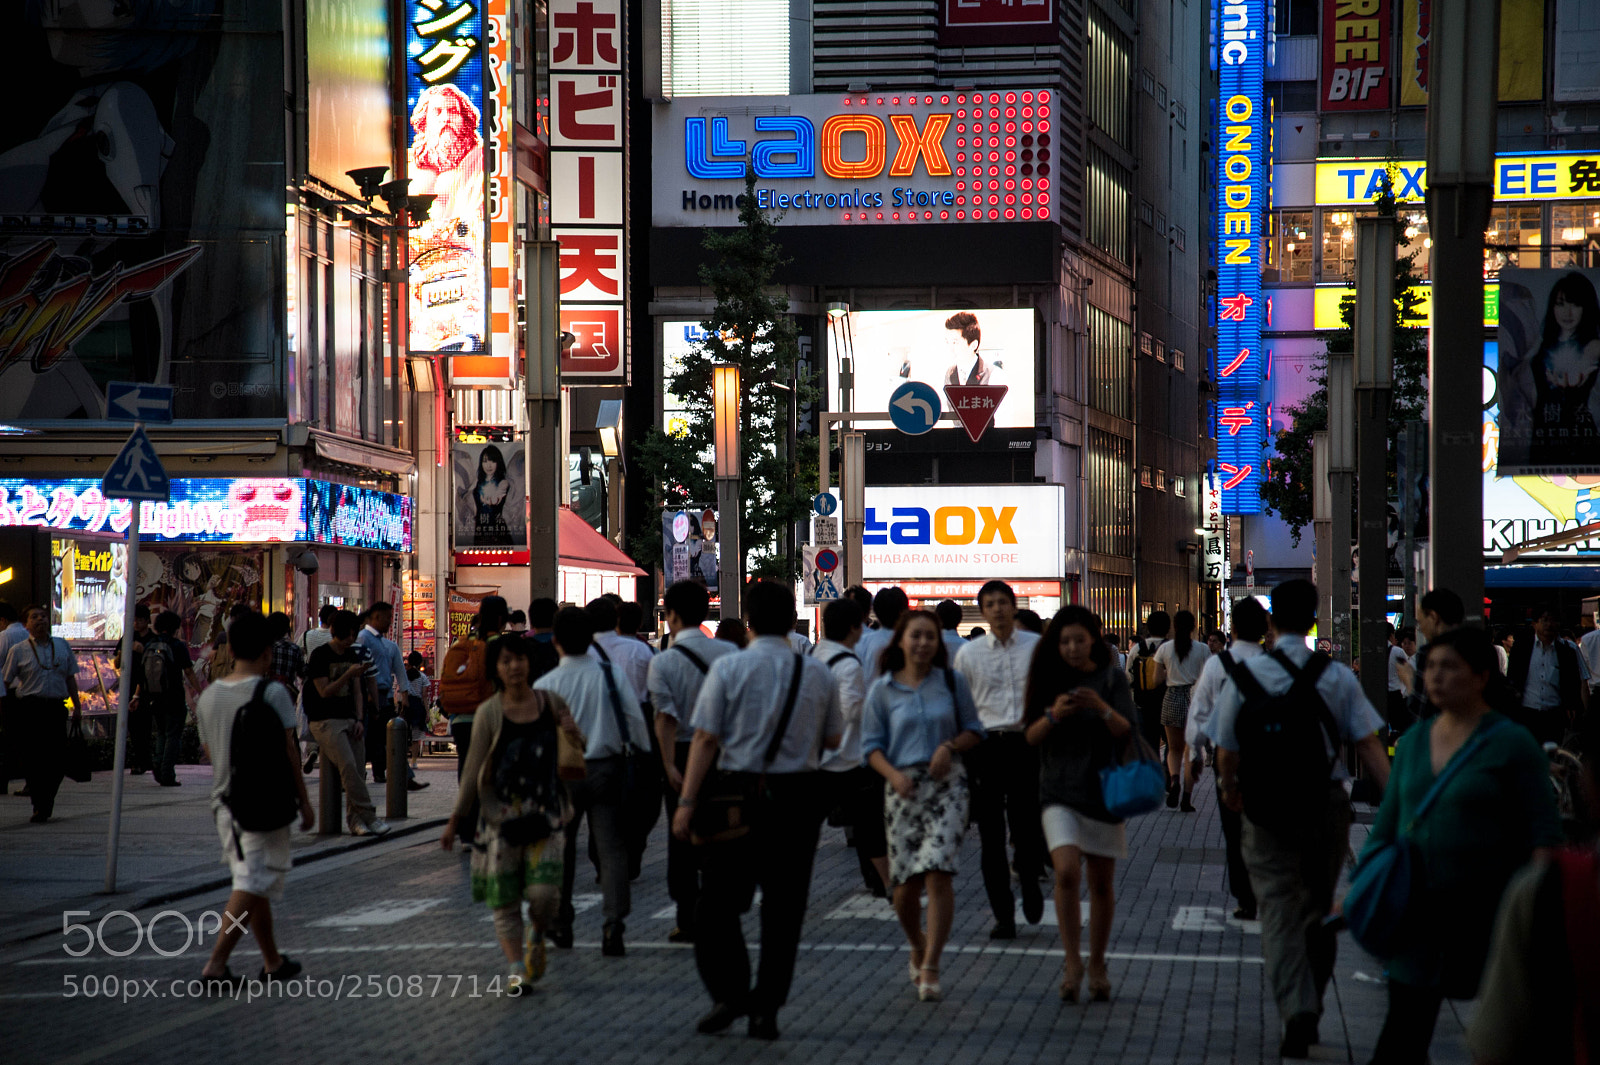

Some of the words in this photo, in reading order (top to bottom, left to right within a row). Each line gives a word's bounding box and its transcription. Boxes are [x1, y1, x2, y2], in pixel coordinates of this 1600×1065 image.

[1222, 0, 1256, 66] nic
[1328, 66, 1385, 101] B1F
[1224, 94, 1253, 265] ONODEN
[1338, 167, 1426, 200] TAX
[1501, 163, 1555, 194] EE
[757, 188, 883, 210] Electronics
[892, 187, 954, 207] Store
[957, 396, 995, 410] 止まれ
[1220, 292, 1255, 491] オノデン
[861, 553, 930, 564] KIHABARA
[934, 553, 968, 564] MAIN
[973, 553, 1019, 564] STORE
[935, 585, 960, 595] DUTY
[961, 585, 982, 595] FRE
